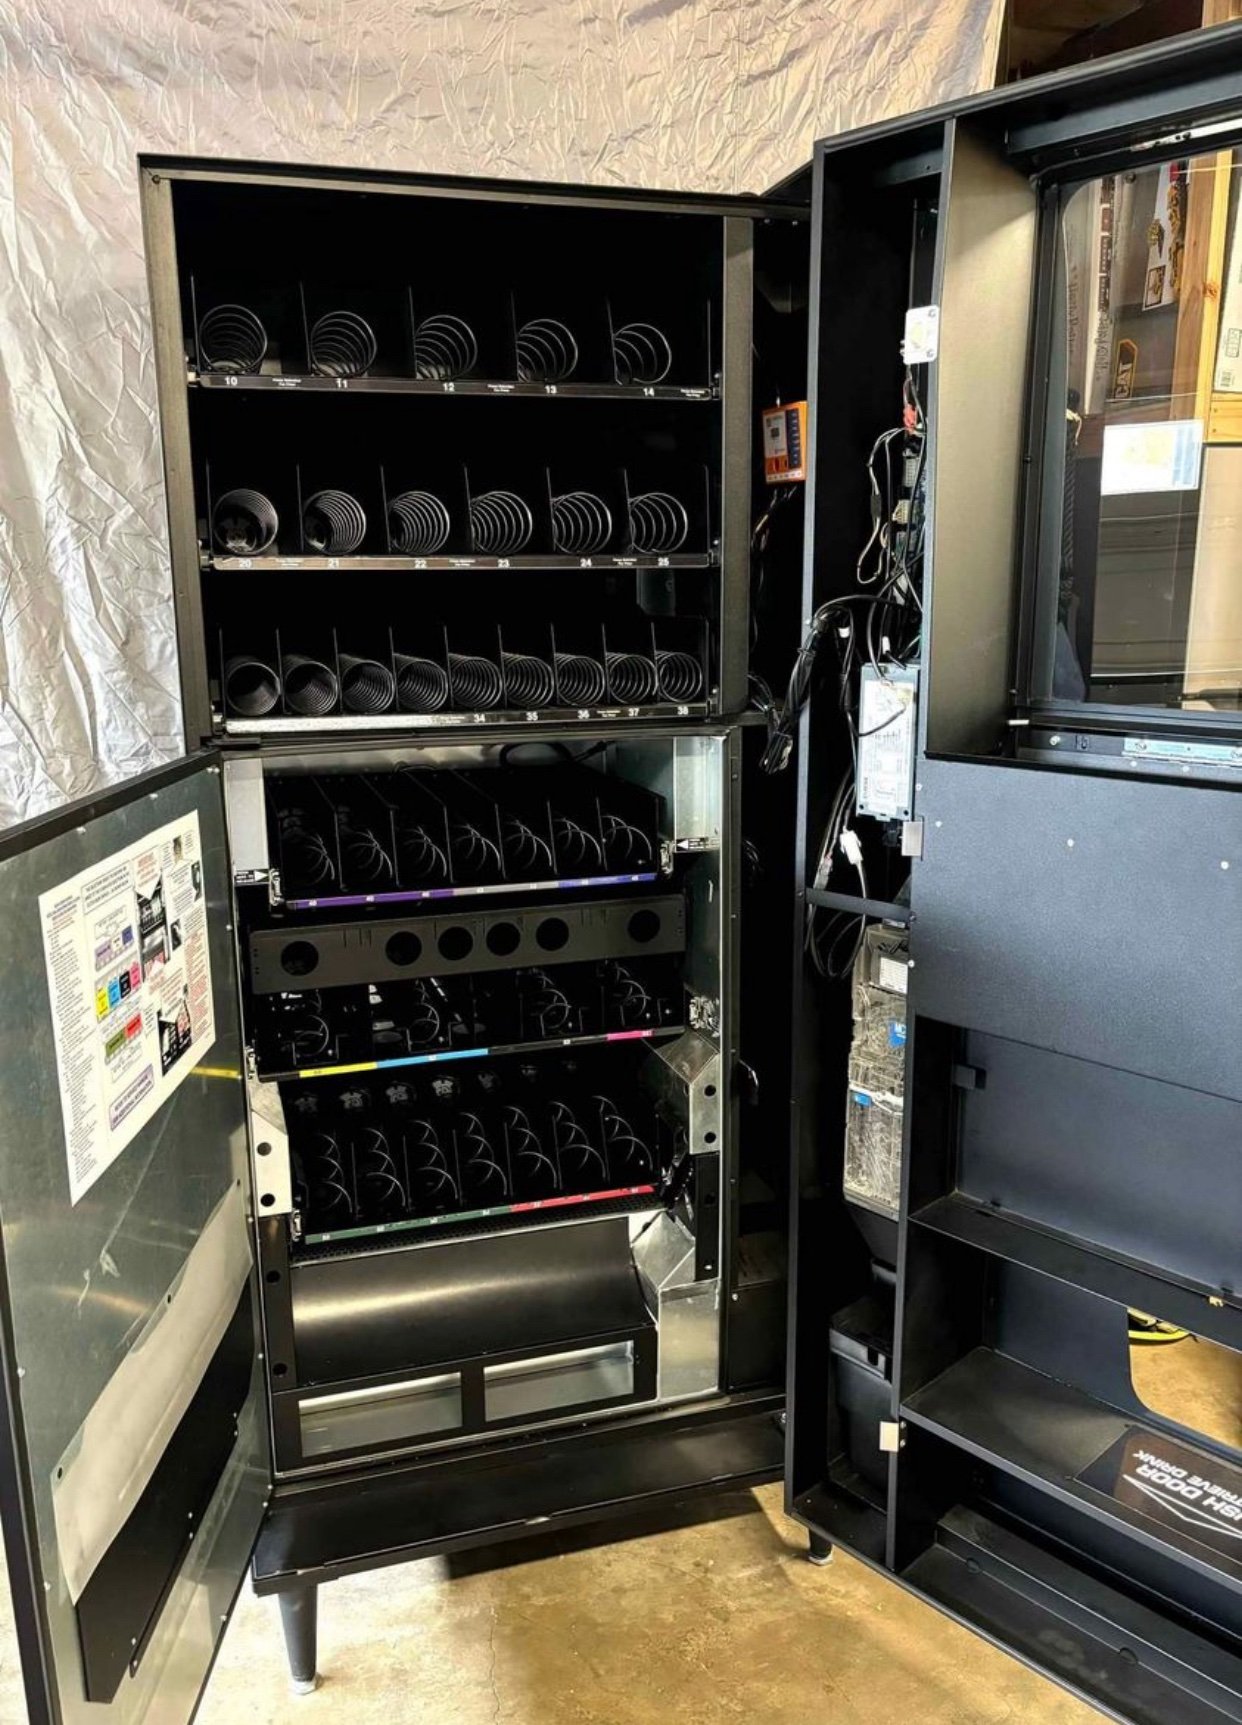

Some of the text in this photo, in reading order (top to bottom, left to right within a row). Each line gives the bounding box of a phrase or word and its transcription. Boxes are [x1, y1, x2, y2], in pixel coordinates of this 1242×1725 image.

[224, 376, 238, 386] 10
[336, 378, 348, 388] 11
[1116, 363, 1132, 398] CAT
[443, 382, 455, 392] 12
[545, 385, 557, 394] 13
[643, 387, 655, 396] 14
[239, 558, 252, 568] 20
[328, 558, 339, 568] 21
[414, 559, 427, 569] 22
[497, 559, 510, 567] 23
[580, 558, 592, 567] 24
[657, 557, 670, 566] 25
[577, 709, 590, 719] 36
[628, 707, 640, 717] 37
[677, 705, 689, 715] 38
[473, 713, 486, 723] 34
[526, 711, 538, 721] 35
[1132, 1450, 1188, 1478] DRINK
[1136, 1464, 1203, 1499] DOOR
